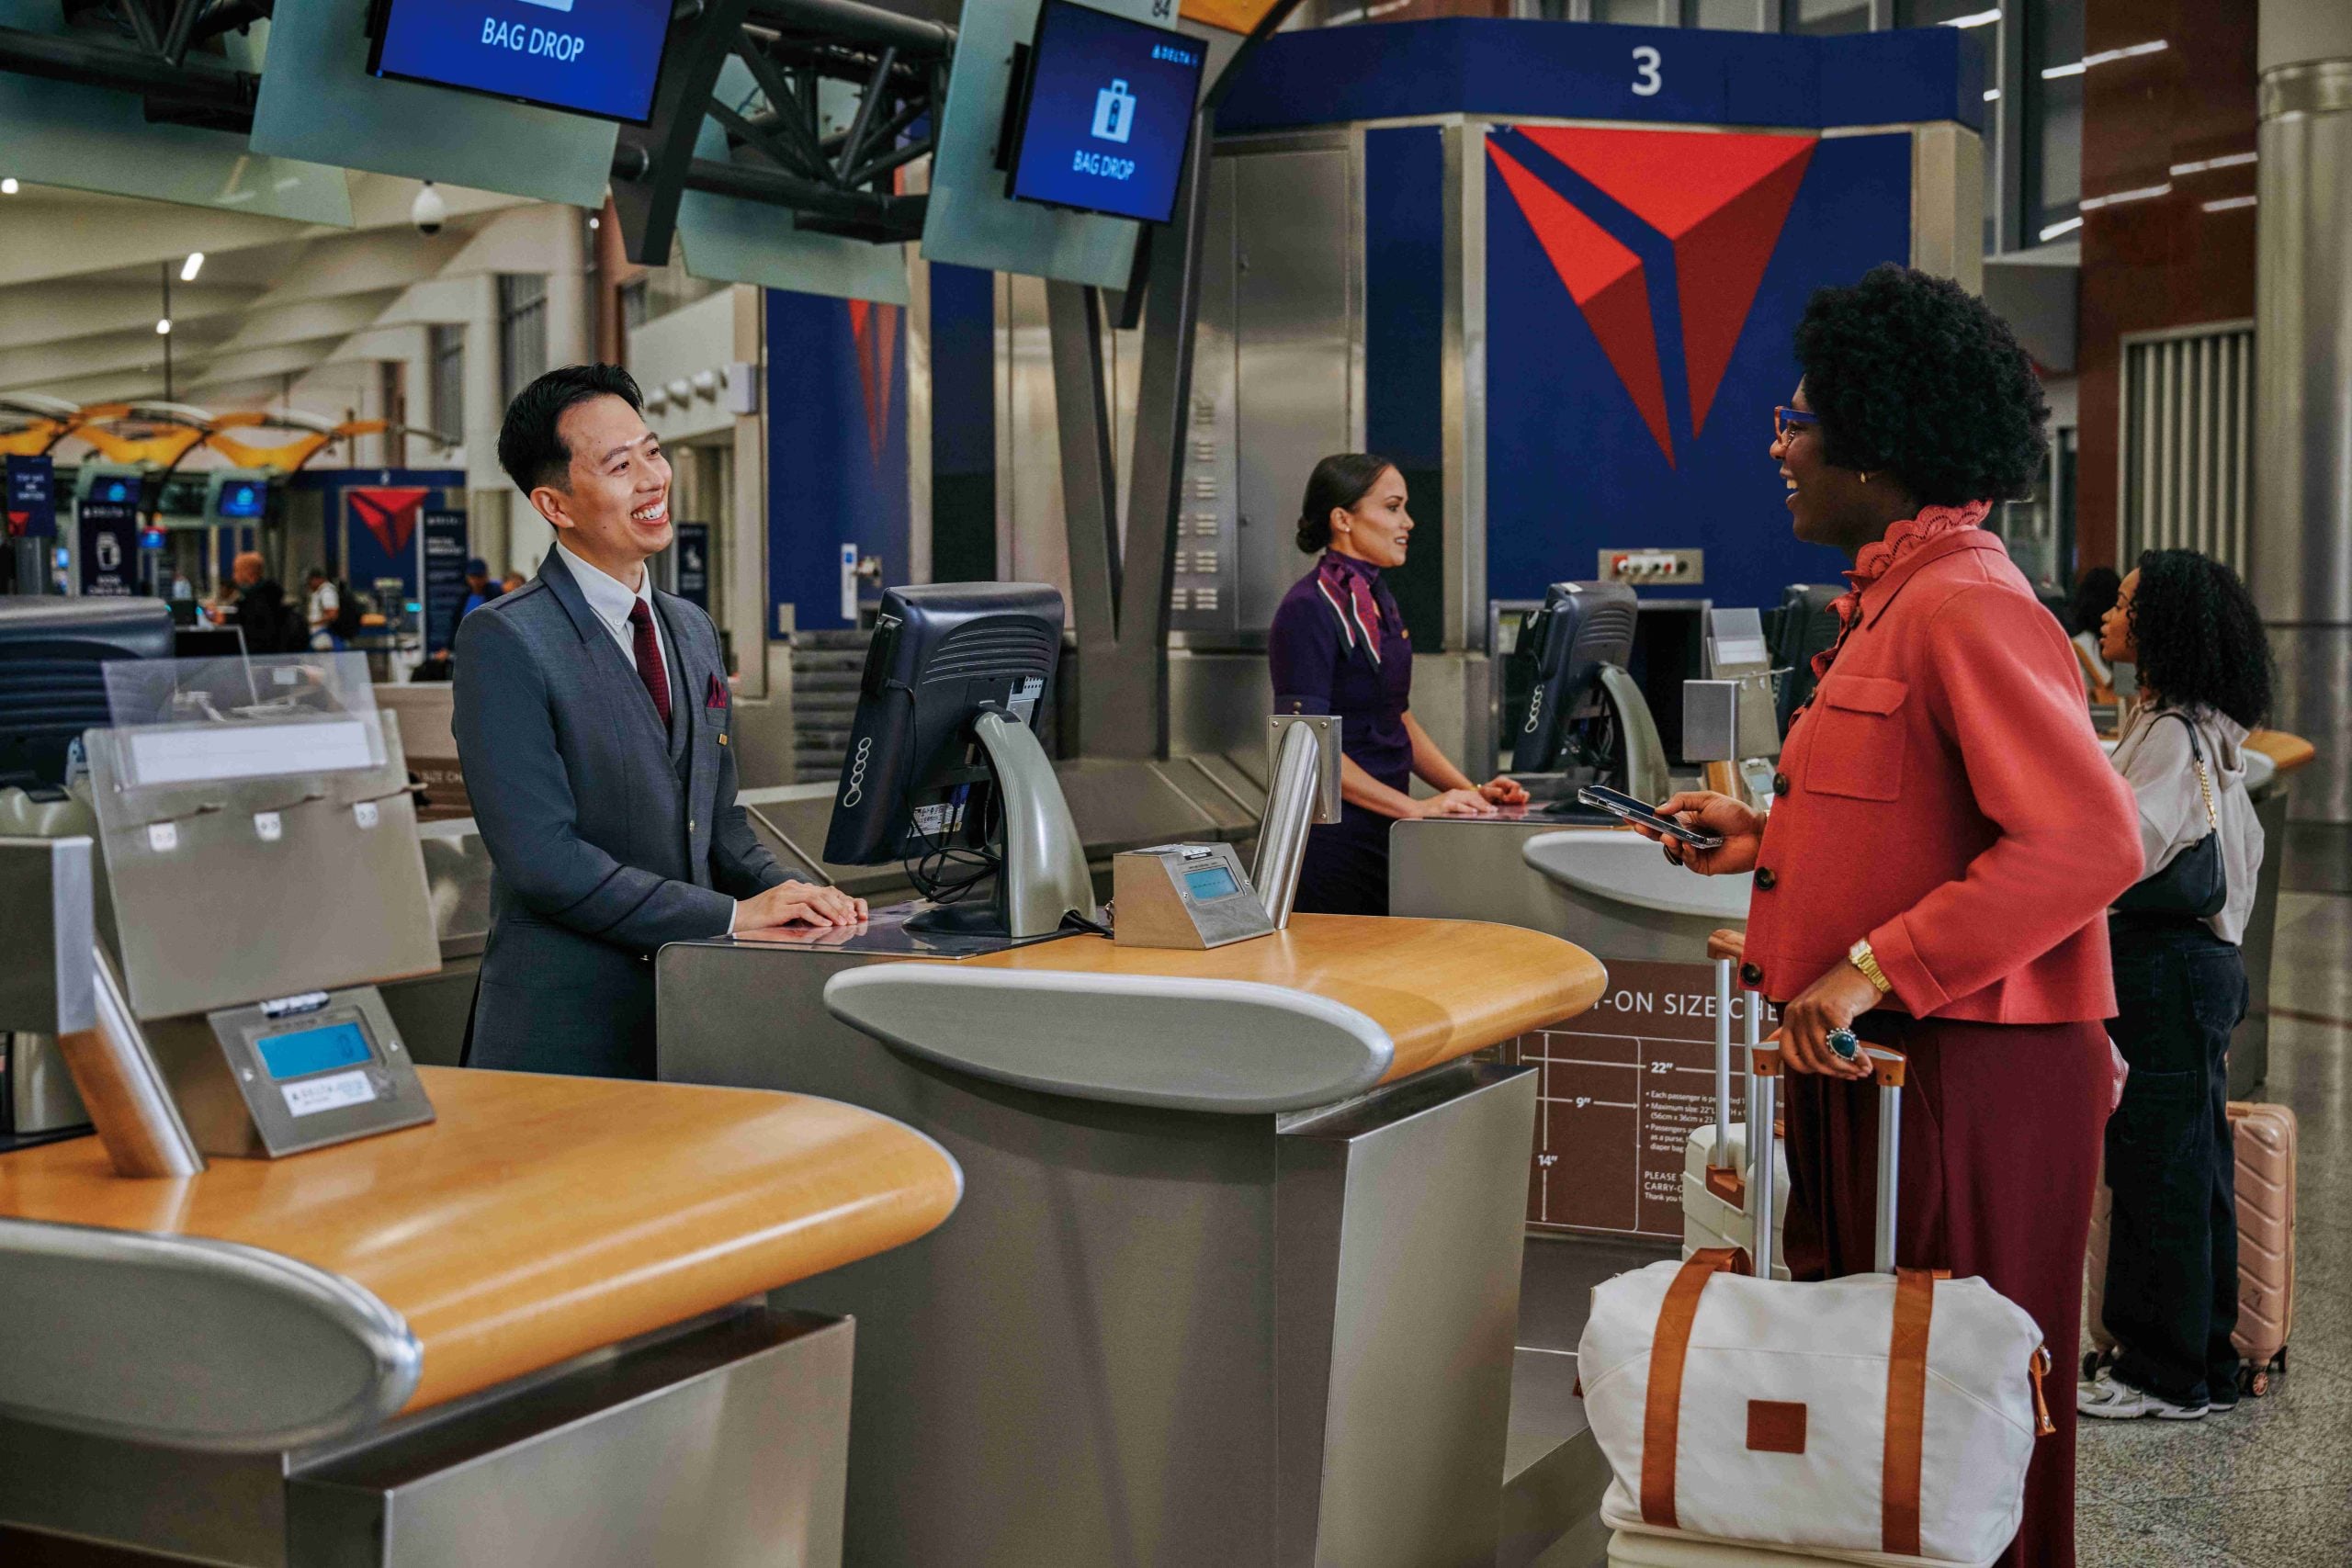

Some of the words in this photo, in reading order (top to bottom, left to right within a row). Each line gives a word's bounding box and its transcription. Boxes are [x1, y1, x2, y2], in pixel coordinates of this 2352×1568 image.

[481, 17, 526, 51] BAG
[528, 28, 584, 62] DROP
[1632, 45, 1662, 96] 3
[1072, 149, 1100, 175] BAG
[1100, 155, 1136, 181] DROP
[1664, 993, 1716, 1017] SIZE
[1651, 1061, 1673, 1074] 22"
[1576, 1096, 1591, 1109] 9"
[1650, 1090, 1668, 1099] Each
[1668, 1093, 1701, 1103] passenger
[1650, 1102, 1684, 1111] Maximum
[1650, 1122, 1687, 1134] Passengers
[1650, 1143, 1670, 1152] diaper
[1538, 1154, 1559, 1166] 14"
[1645, 1170, 1677, 1181] PLEASE
[1645, 1191, 1665, 1201] Thank
